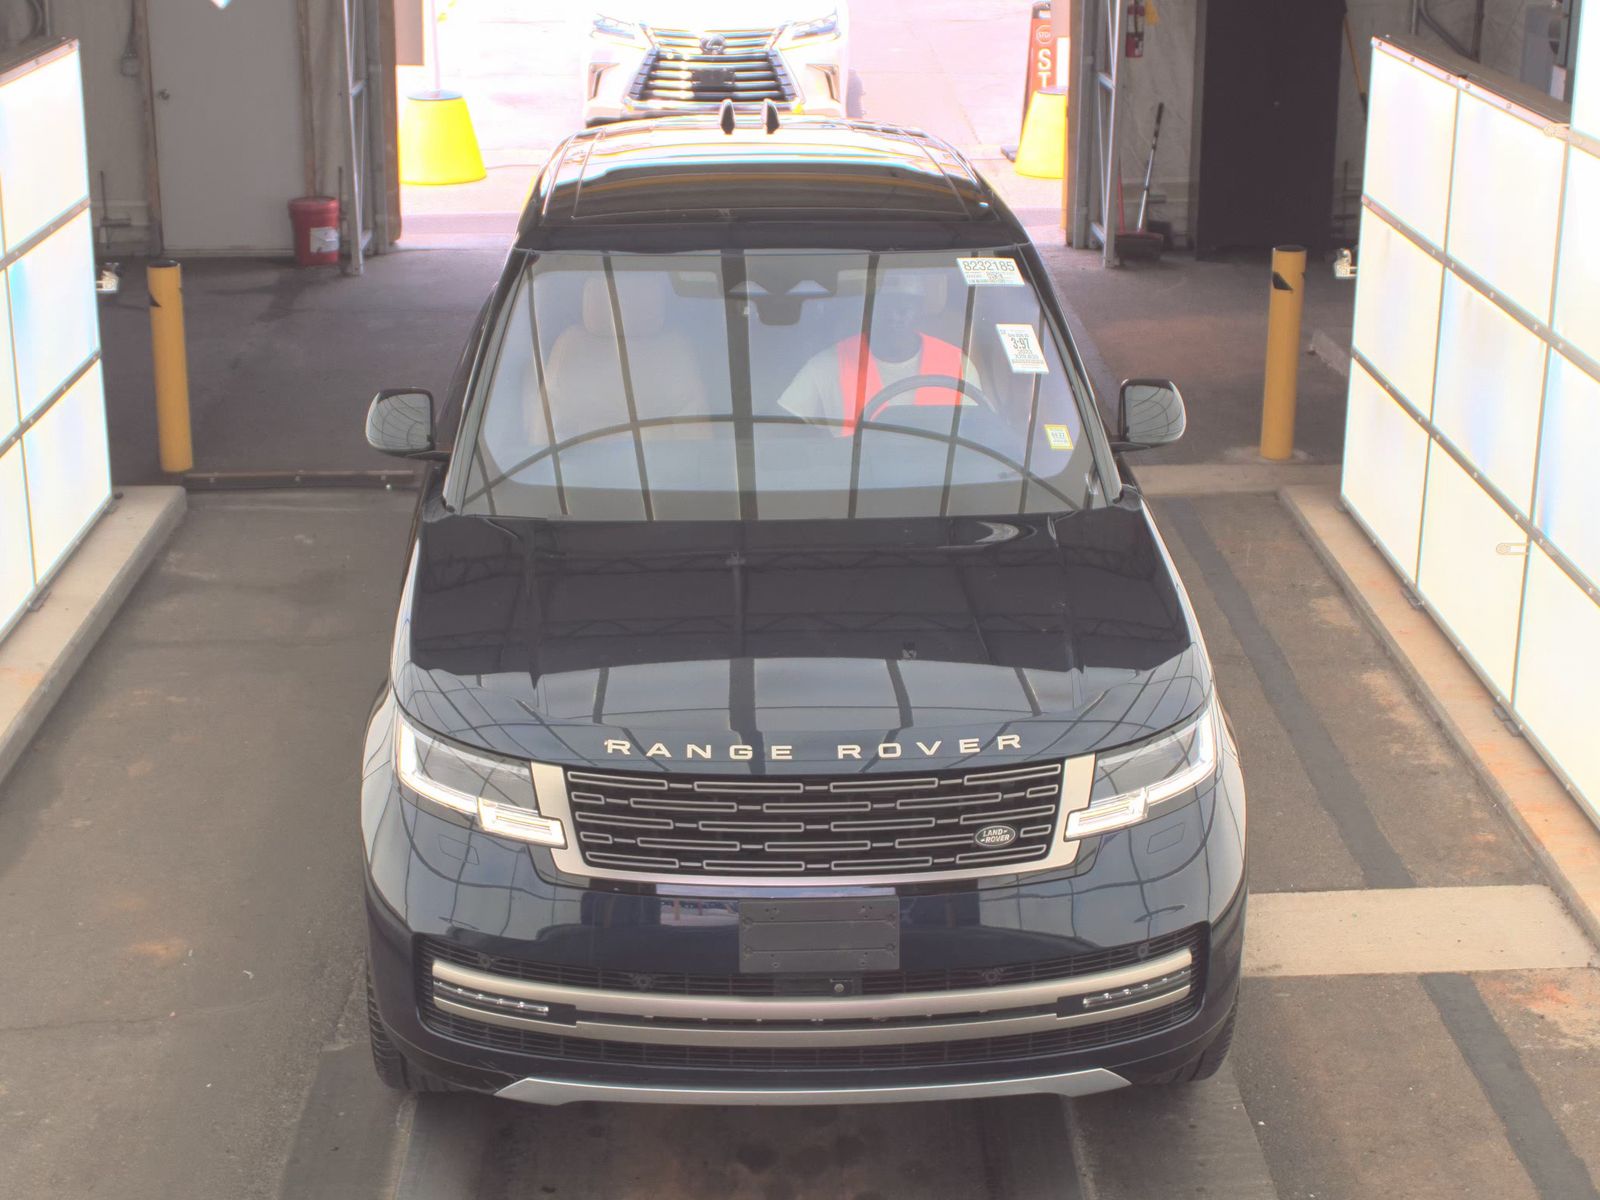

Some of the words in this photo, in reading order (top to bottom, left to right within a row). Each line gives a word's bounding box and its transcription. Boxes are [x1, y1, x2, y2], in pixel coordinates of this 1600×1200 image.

[962, 260, 1015, 272] 8232185
[605, 739, 793, 760] RANGE
[837, 734, 1021, 760] ROVER
